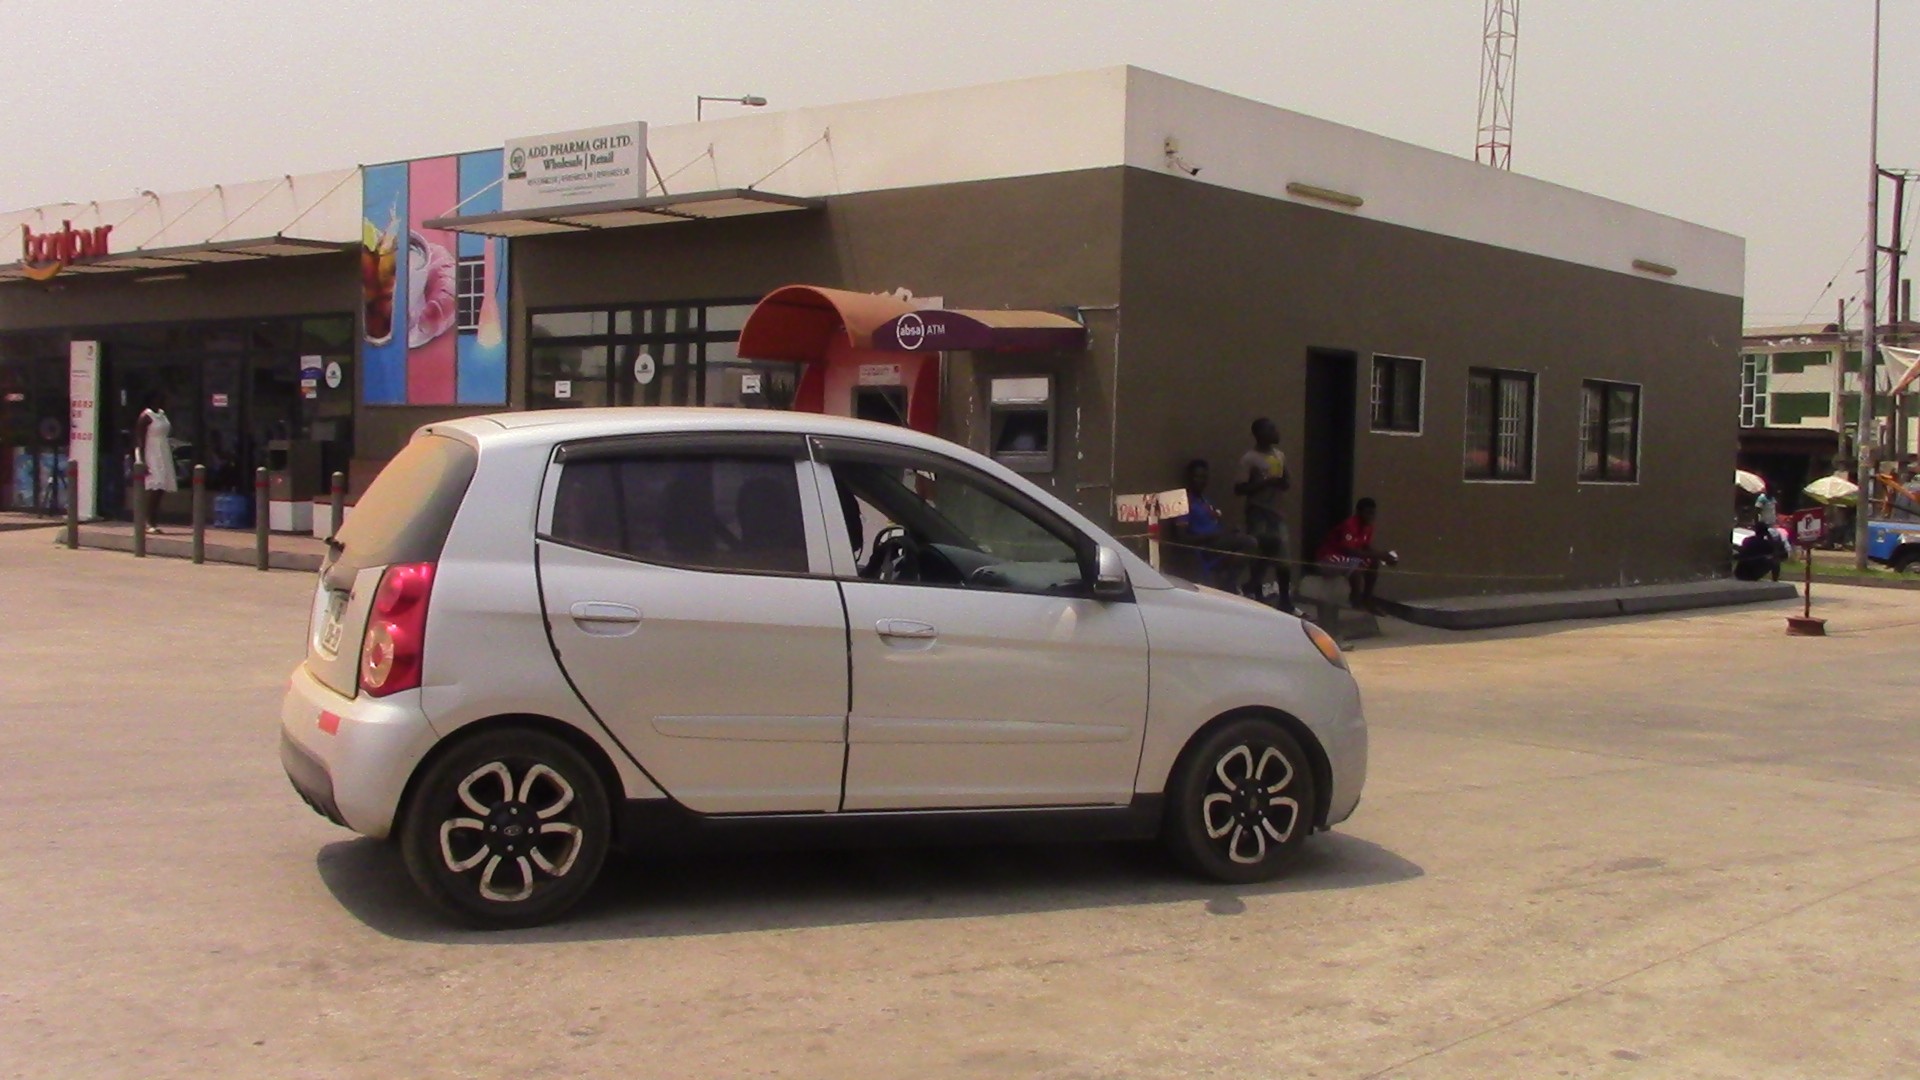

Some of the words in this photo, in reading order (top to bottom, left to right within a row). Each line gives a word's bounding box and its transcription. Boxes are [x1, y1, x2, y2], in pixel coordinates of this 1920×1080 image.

[528, 147, 548, 159] ADD
[551, 141, 590, 156] PHARMA
[592, 137, 608, 150] GH
[543, 156, 583, 170] Wholesale
[590, 151, 614, 165] Retail
[21, 219, 113, 266] bonjour
[900, 323, 921, 336] absa
[926, 324, 946, 335] ATM
